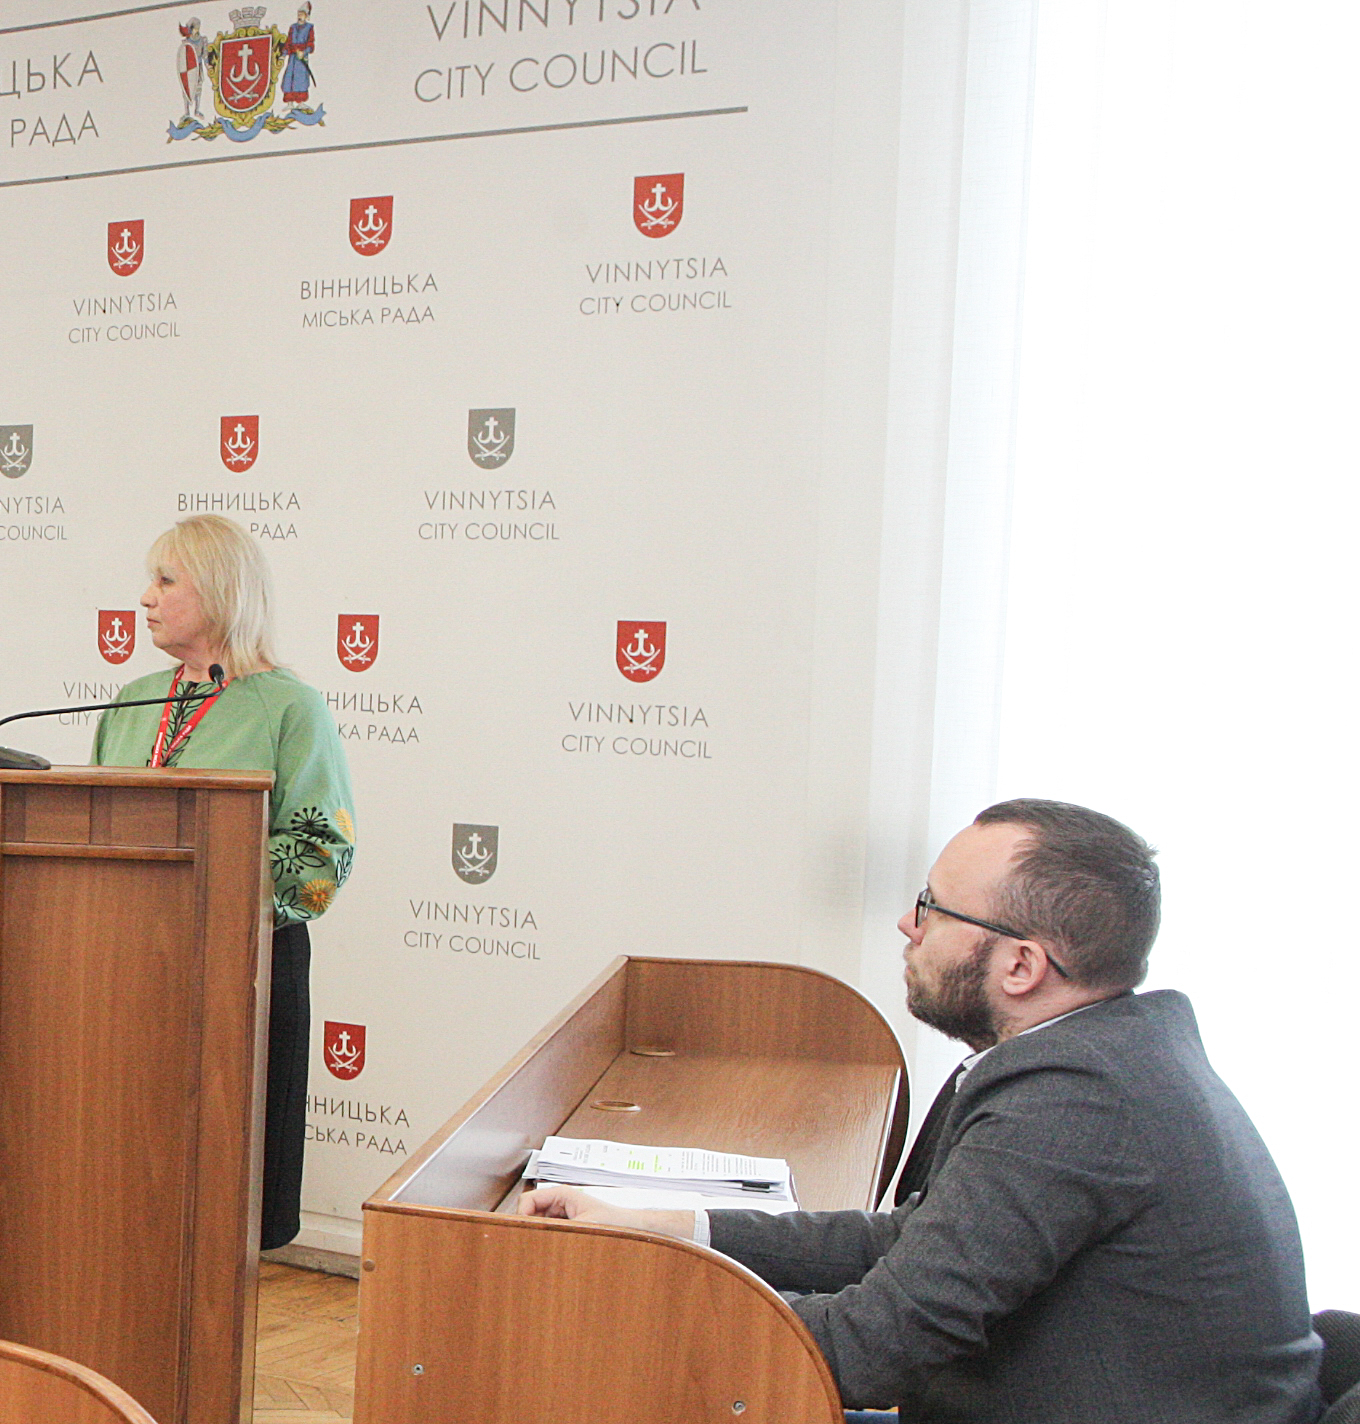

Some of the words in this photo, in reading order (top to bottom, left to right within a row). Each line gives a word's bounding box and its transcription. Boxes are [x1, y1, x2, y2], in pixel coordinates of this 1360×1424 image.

[413, 62, 495, 103] CITY
[508, 39, 708, 93] COUNCIL
[10, 109, 100, 148] РАДА
[585, 257, 728, 284] VINNYTSIA
[300, 273, 438, 301] ВІННИЦЬКА
[72, 292, 177, 316] VINNYTSIA
[579, 296, 623, 316] CITY
[630, 291, 732, 313] COUNCIL
[302, 309, 374, 328] МІСЬКА
[380, 305, 435, 325] РАДА
[68, 327, 101, 344] CITY
[106, 321, 180, 342] COUNCIL
[177, 491, 301, 513] ВІННИЦЬКА
[424, 489, 556, 511] VINNYTSIA
[250, 522, 298, 541] РАДА
[418, 522, 458, 540] CITY
[464, 522, 559, 541] COUNCIL
[326, 691, 423, 715] НИЦЬКА
[568, 701, 709, 728] VINNYTSIA
[367, 724, 420, 745] РАДА
[561, 734, 606, 754] CITY
[613, 735, 712, 760] COUNCIL
[409, 899, 538, 931] VINNYTSIA
[403, 930, 443, 949] CITY
[448, 934, 541, 961] COUNCIL
[306, 1094, 410, 1129] НИЦЬКА
[304, 1123, 350, 1147] СЬКА
[355, 1131, 408, 1156] РАДА
